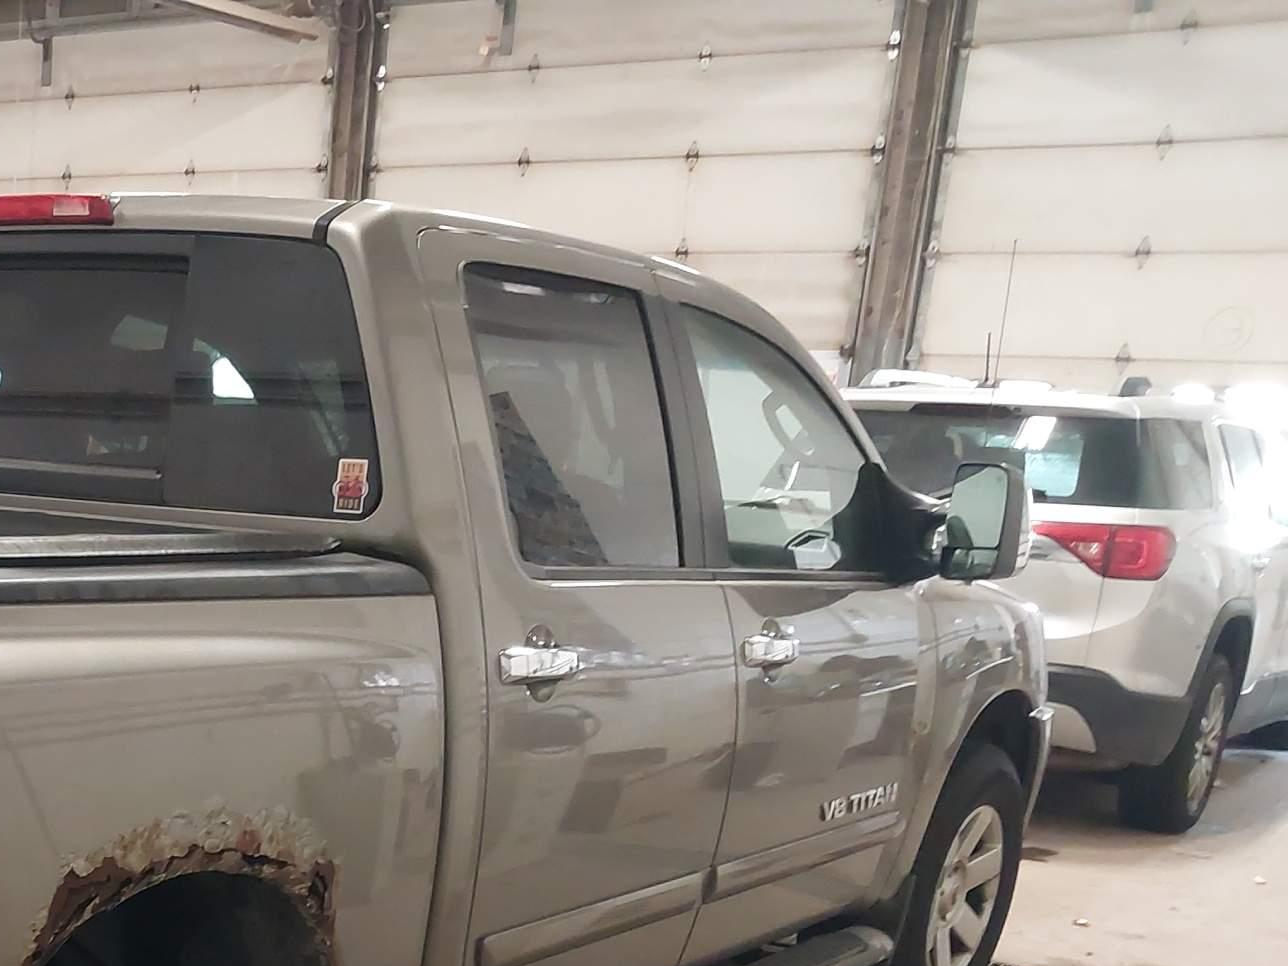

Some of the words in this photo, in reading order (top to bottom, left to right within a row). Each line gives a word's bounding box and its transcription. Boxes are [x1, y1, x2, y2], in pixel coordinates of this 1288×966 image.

[337, 497, 360, 510] RIDE
[819, 796, 847, 821] V8
[848, 782, 899, 814] TITAN
